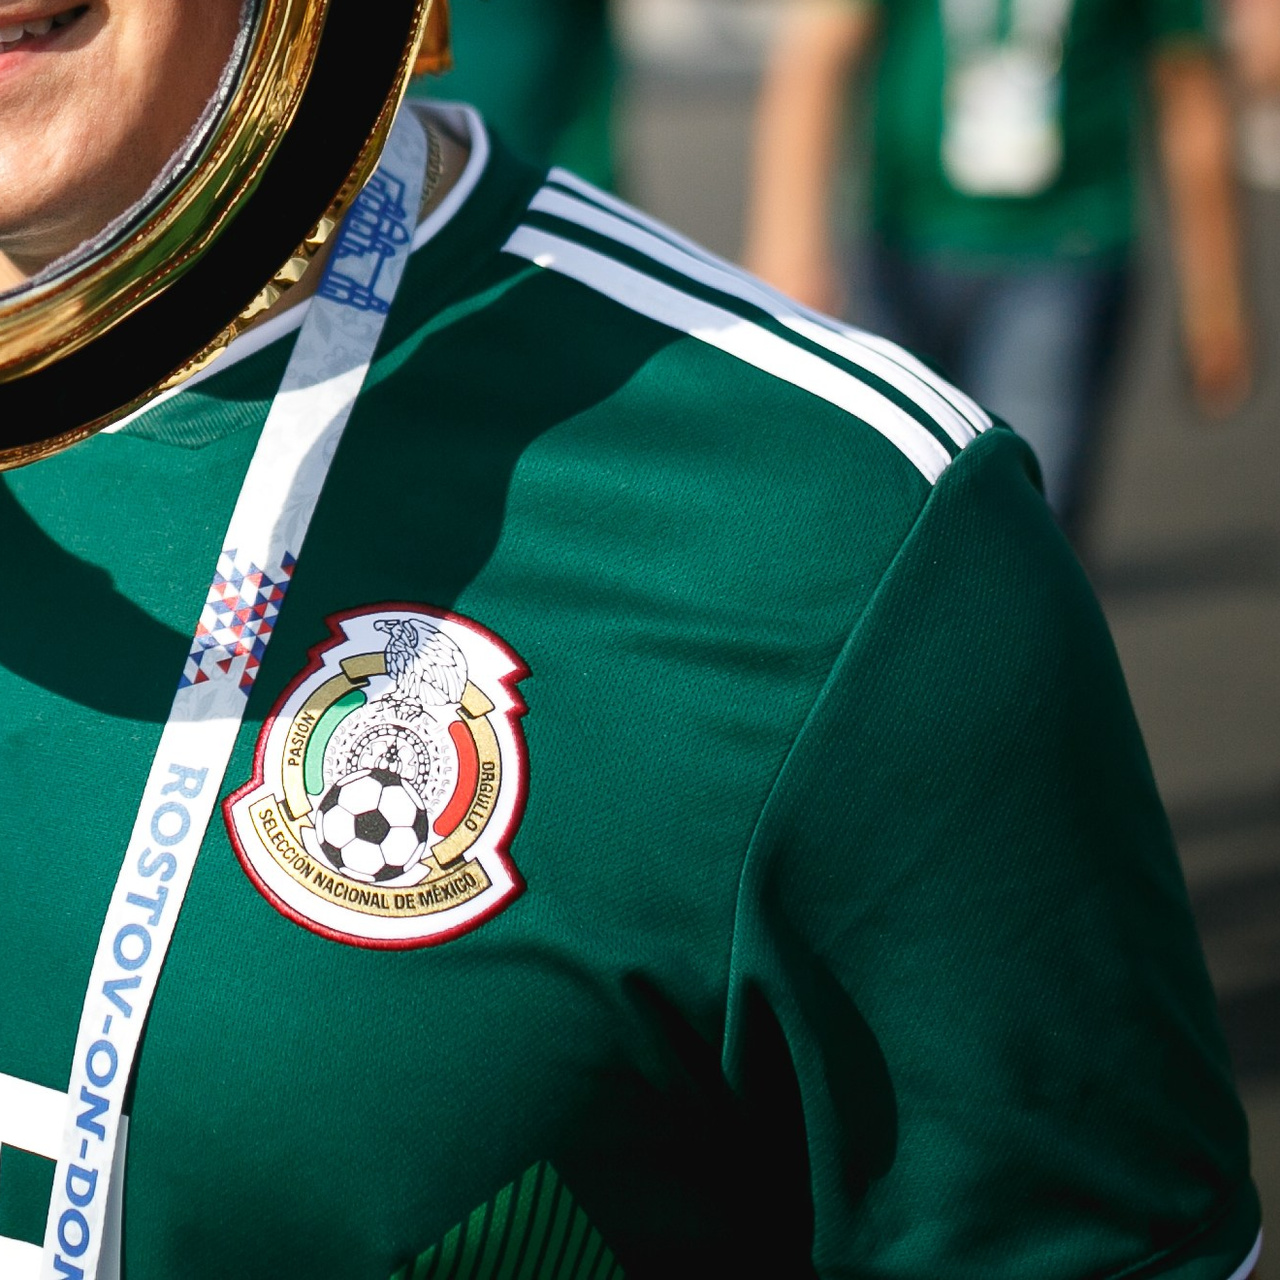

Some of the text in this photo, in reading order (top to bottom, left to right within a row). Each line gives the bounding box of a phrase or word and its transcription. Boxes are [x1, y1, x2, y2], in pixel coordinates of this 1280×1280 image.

[287, 711, 315, 766] PASIÓN
[464, 761, 495, 832] ORGULLO
[259, 808, 478, 910] SELECCIÓN NACIONAL DE MÉXICO
